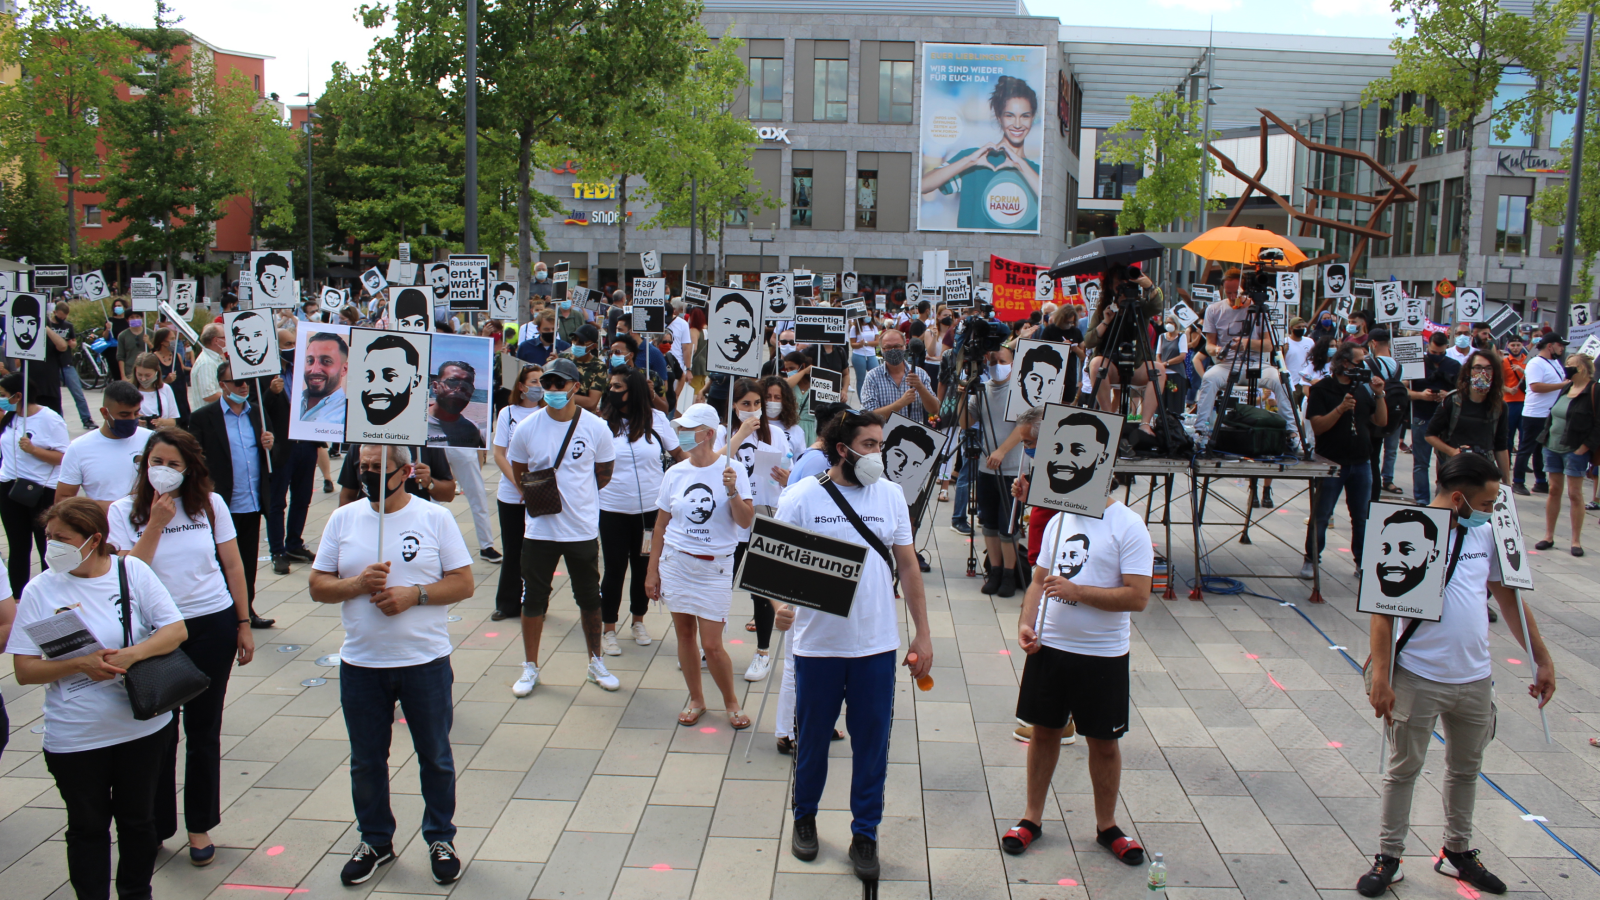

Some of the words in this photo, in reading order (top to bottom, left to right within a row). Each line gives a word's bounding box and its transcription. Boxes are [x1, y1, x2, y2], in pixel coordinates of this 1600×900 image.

[956, 53, 1028, 62] LIEBLINGSPLATZ.
[930, 72, 947, 81] FÜR
[990, 203, 1020, 211] HANAU
[451, 269, 477, 278] ent-
[451, 278, 484, 288] waff-
[635, 279, 657, 288] #say
[1005, 273, 1036, 286] Han
[451, 288, 479, 298] nen!
[634, 288, 654, 296] their
[995, 298, 1025, 310] den
[797, 315, 842, 324] Gerechtig-
[811, 378, 832, 390] Konse-
[817, 391, 839, 402] quenzen!
[1043, 498, 1063, 506] Sedat
[1064, 501, 1088, 511] Gürbüz
[752, 536, 861, 578] Aufklärung!
[1376, 602, 1396, 611] Sedat
[1398, 604, 1423, 614] Gürbüz
